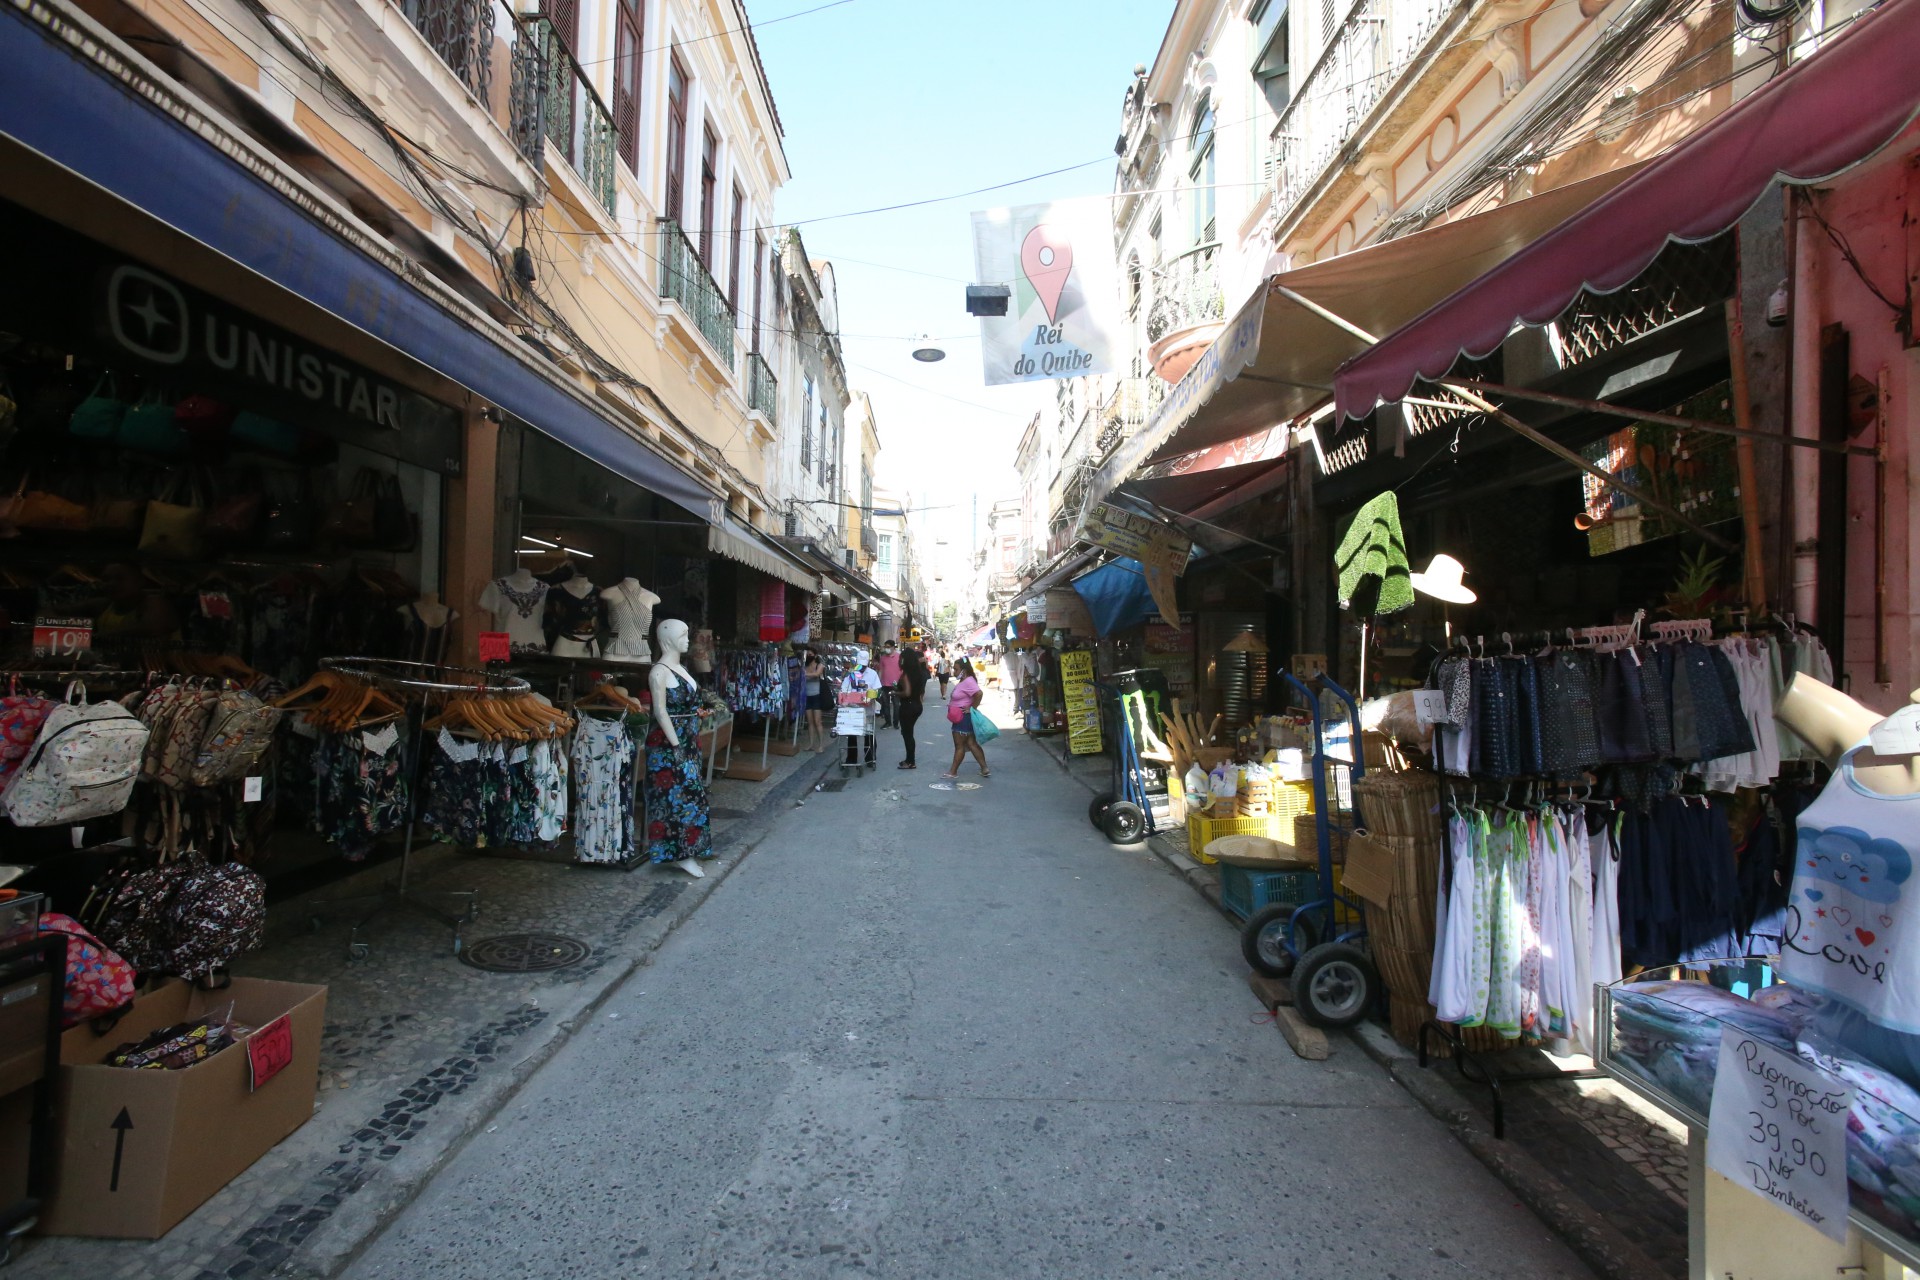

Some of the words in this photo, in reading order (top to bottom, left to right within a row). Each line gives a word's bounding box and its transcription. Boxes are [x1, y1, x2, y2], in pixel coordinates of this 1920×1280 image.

[1034, 322, 1064, 346] Rei
[204, 313, 401, 431] UNISTAR
[1013, 353, 1036, 376] do
[1041, 348, 1093, 377] Quibe
[46, 618, 83, 627] UNISTAR
[1736, 1039, 1847, 1114] Promoção
[1760, 1084, 1778, 1109] 3
[1787, 1098, 1821, 1135] Por
[1768, 1156, 1795, 1180] No
[1745, 1160, 1825, 1225] Dinheiro
